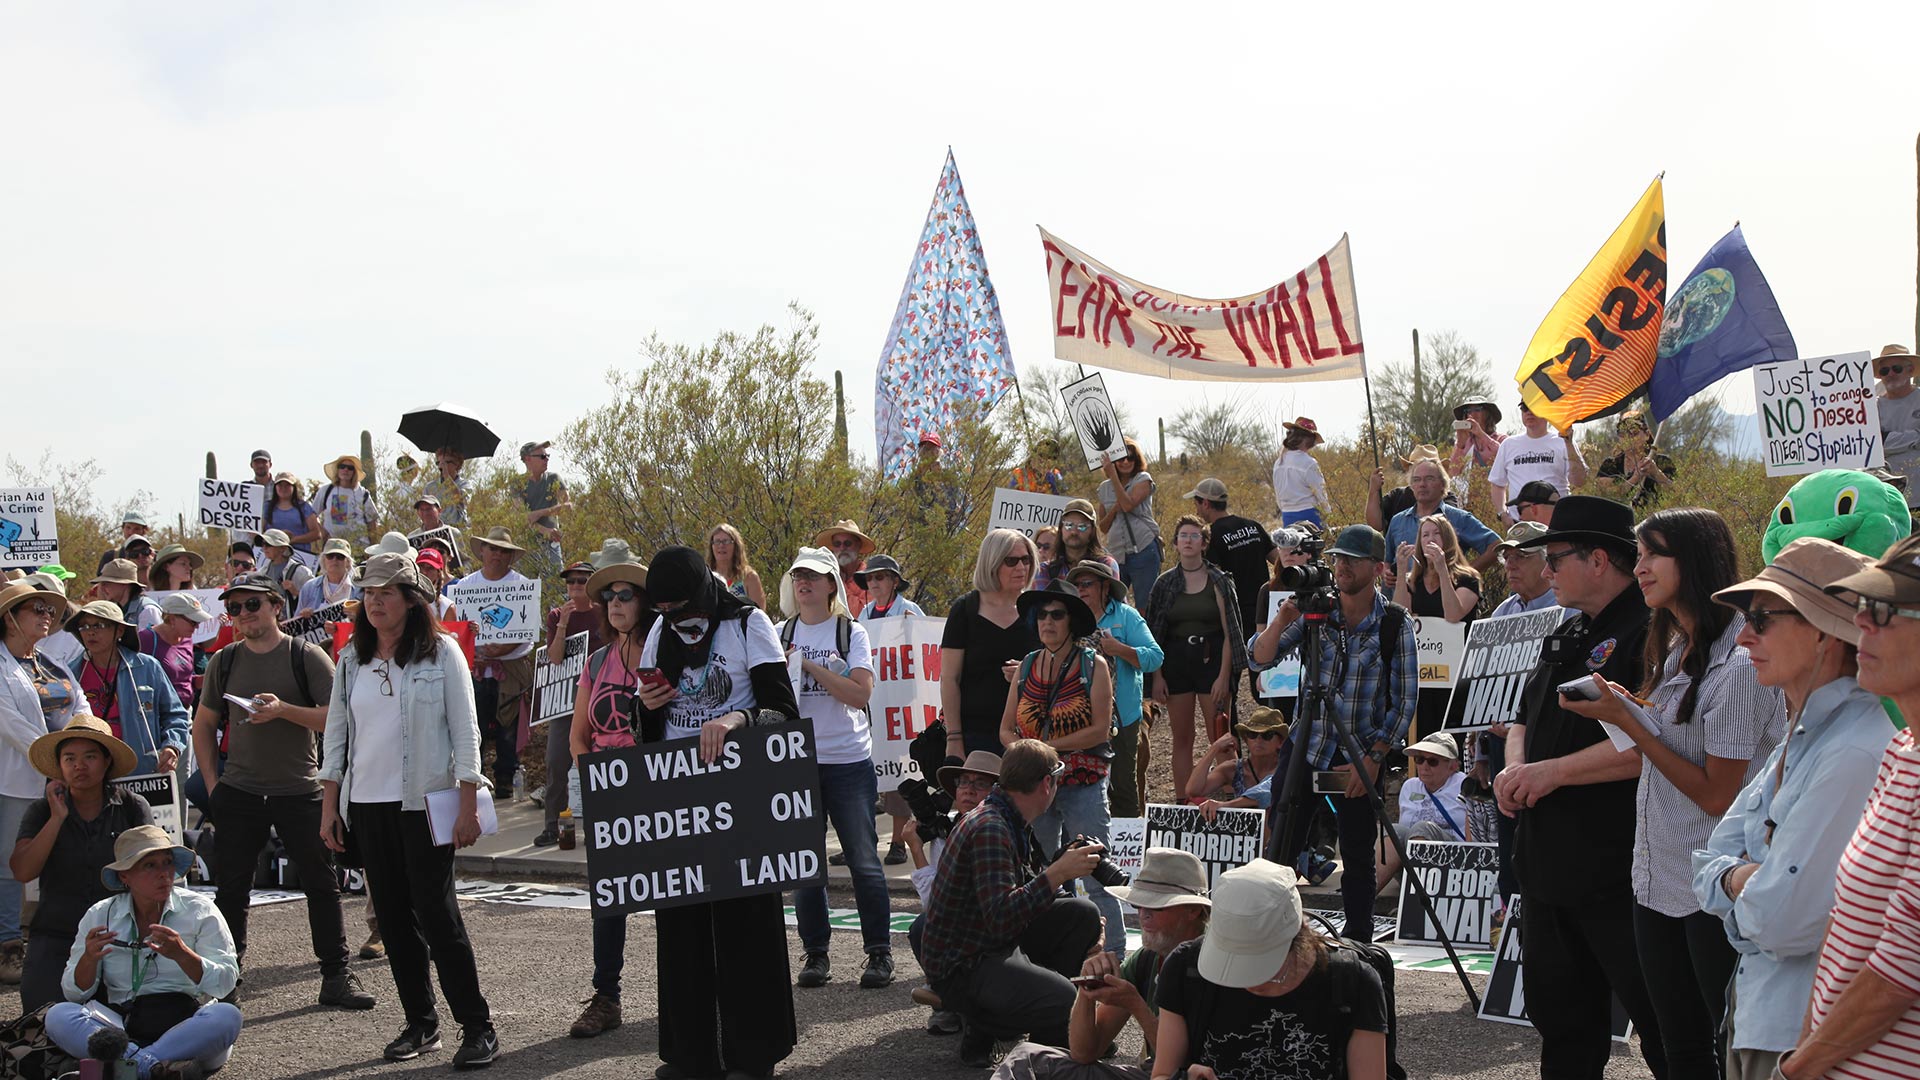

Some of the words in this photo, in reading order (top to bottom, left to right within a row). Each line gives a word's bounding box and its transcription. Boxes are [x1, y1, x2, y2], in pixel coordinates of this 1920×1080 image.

[1149, 320, 1216, 362] THE
[1222, 254, 1364, 368] WALL
[1760, 360, 1813, 396] Just
[1819, 359, 1868, 388] Say
[1811, 391, 1827, 407] to
[1829, 387, 1873, 404] orange
[1762, 397, 1805, 438] NO
[1813, 401, 1867, 429] nosed
[1805, 429, 1876, 467] Stupidity
[26, 492, 45, 501] Aid
[203, 480, 250, 500] SAVE
[9, 504, 44, 514] Crime
[201, 507, 261, 531] DESERT
[219, 500, 252, 513] OUR
[999, 501, 1025, 521] MR.
[1027, 504, 1063, 527] TRUM
[4, 552, 52, 561] Charges
[454, 586, 516, 596] Humanitarian
[520, 583, 535, 591] Aid
[455, 597, 463, 605] Is
[505, 593, 533, 601] Crime
[496, 631, 534, 640] Charges
[536, 664, 549, 689] NO
[548, 653, 585, 684] BORDER
[922, 643, 943, 682] W
[1462, 647, 1489, 679] NO
[1486, 638, 1543, 676] BORDE
[1420, 667, 1446, 679] GAL
[539, 678, 574, 719] WALL
[588, 758, 629, 792] NO
[766, 731, 808, 763] OR
[875, 760, 918, 778] sity.o
[593, 801, 734, 850] BORDERS
[770, 789, 813, 822] ON
[1115, 831, 1143, 842] SAC
[1150, 829, 1175, 851] NO
[1181, 832, 1256, 863] BORDER
[1111, 845, 1142, 857] LACE
[1119, 858, 1142, 867] INTE
[595, 865, 705, 908] STOLEN
[739, 849, 819, 887] LAND
[1409, 867, 1442, 896] NO
[1445, 869, 1499, 898] BOR
